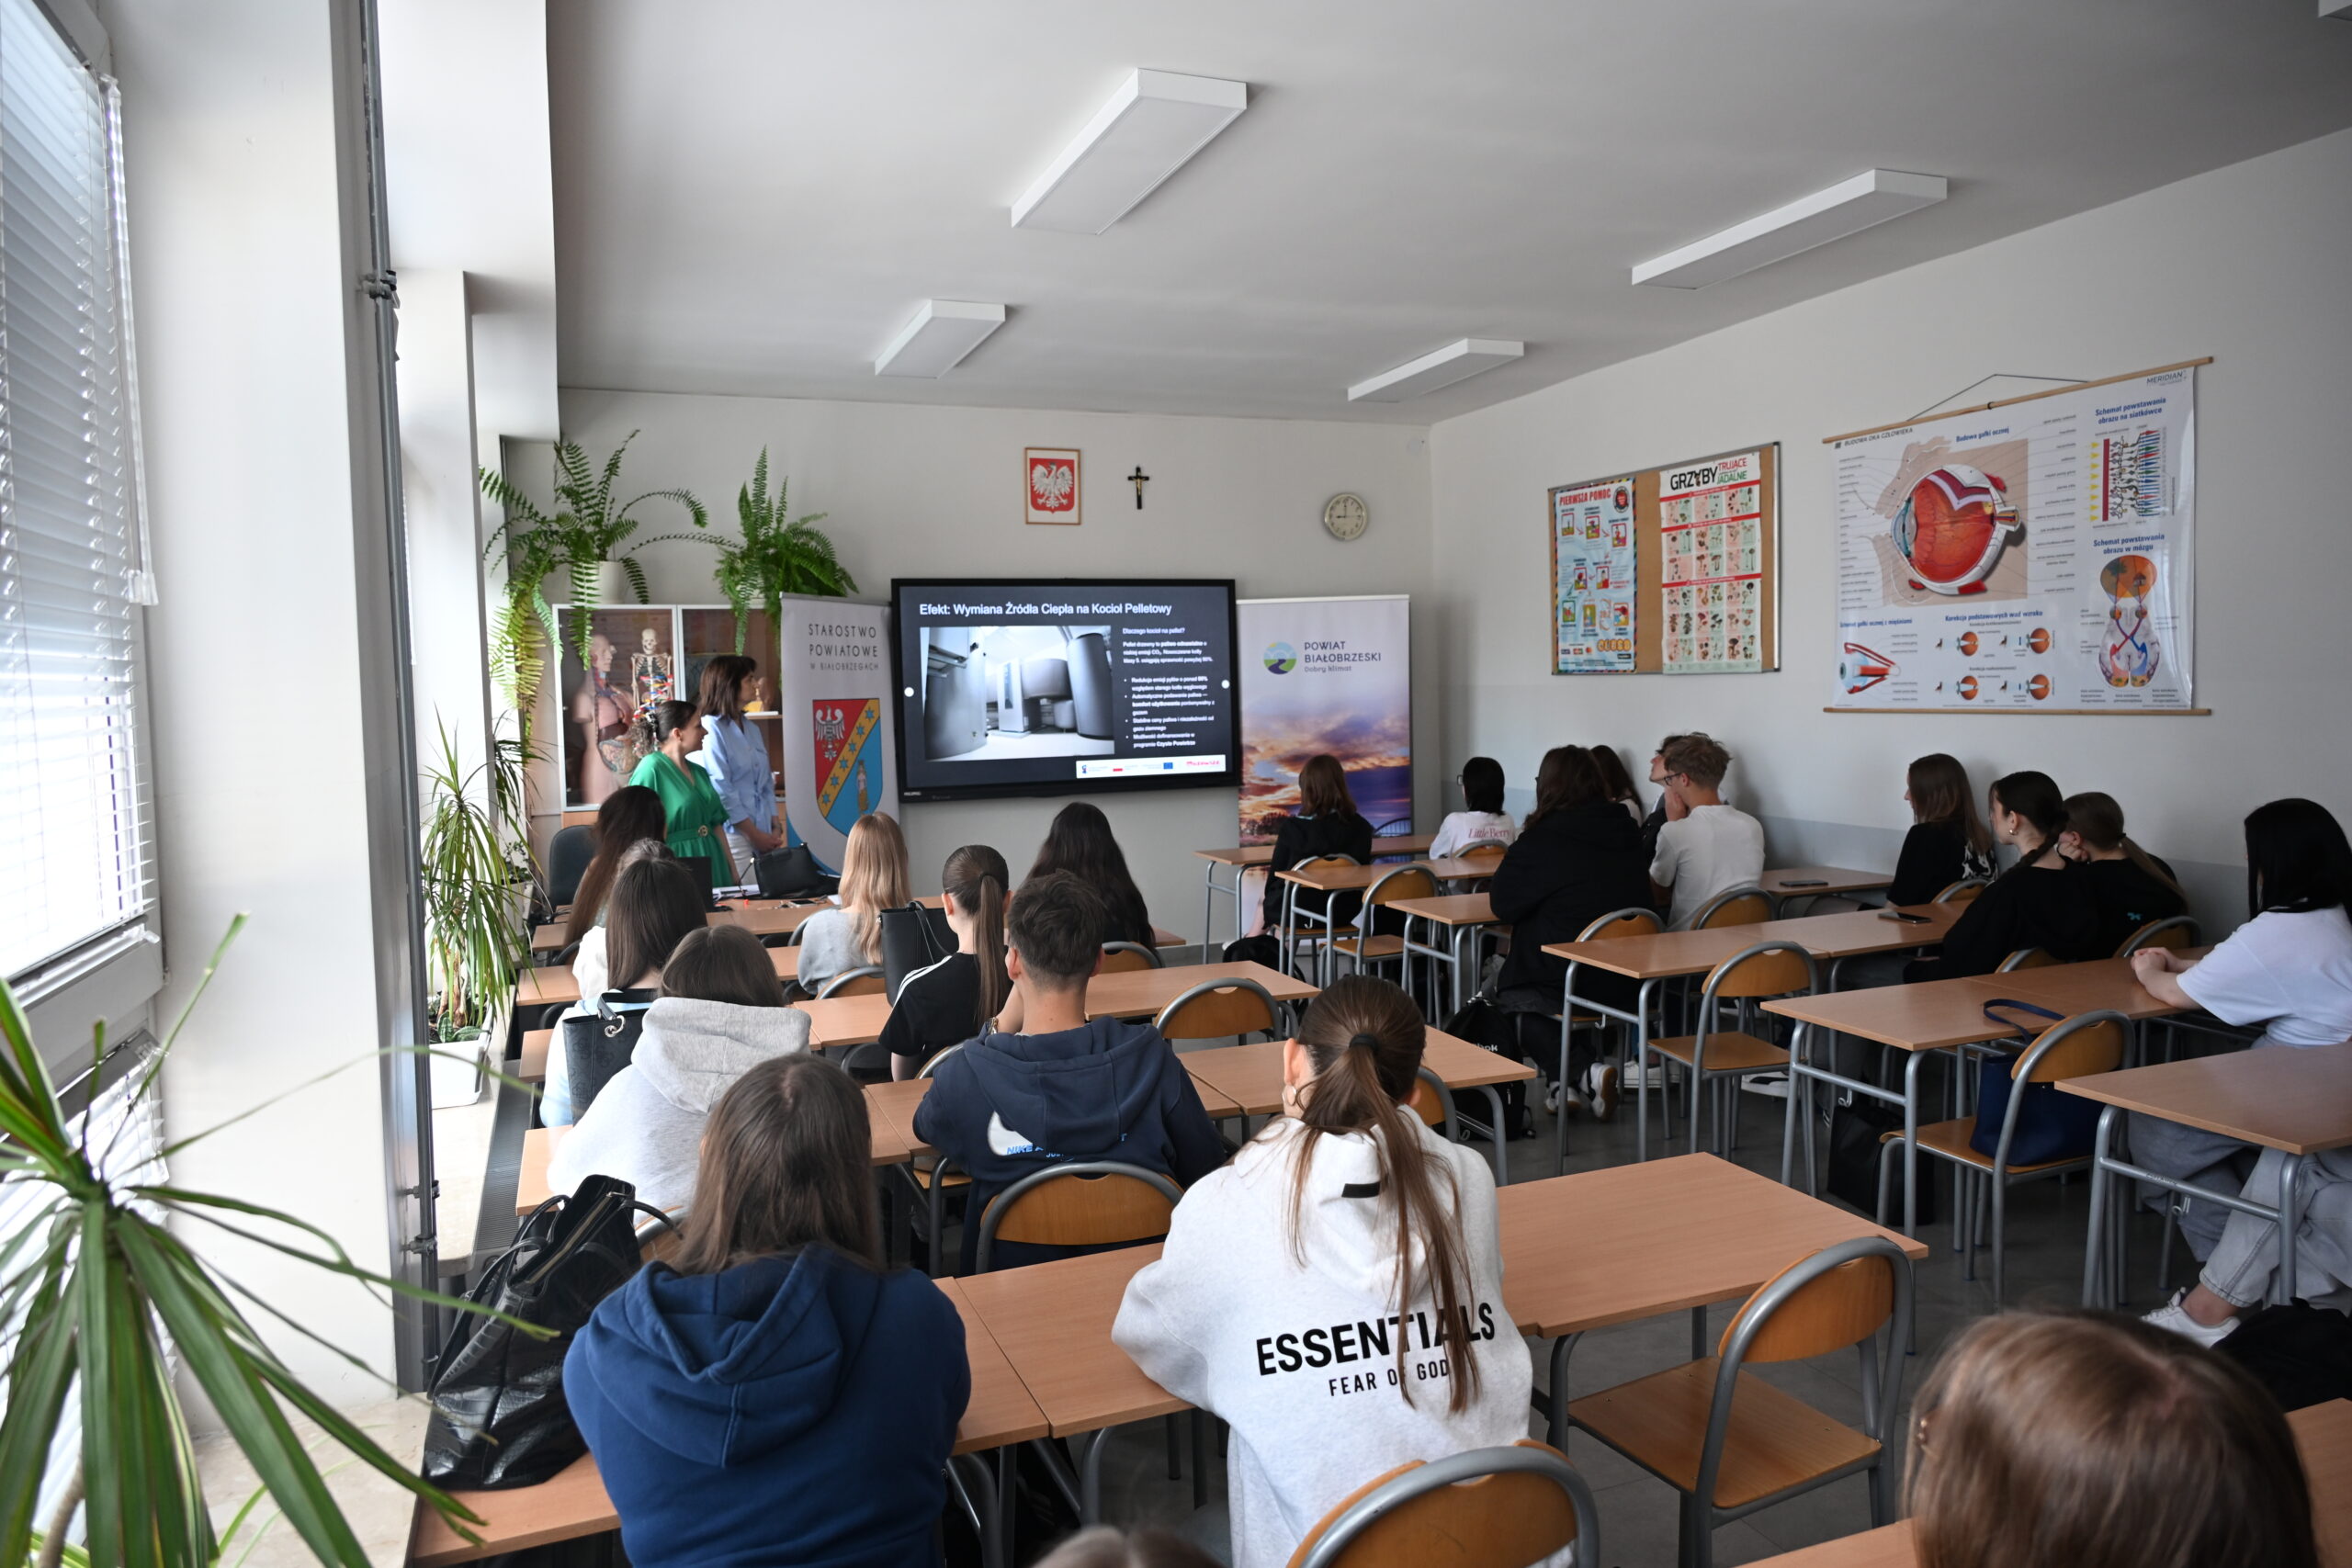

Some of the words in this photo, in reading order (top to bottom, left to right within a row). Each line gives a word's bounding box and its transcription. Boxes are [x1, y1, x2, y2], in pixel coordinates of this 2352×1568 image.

[2146, 371, 2183, 384] MERIDIAN
[2095, 406, 2122, 416] Schemat
[2123, 397, 2166, 412] powstawania
[1670, 466, 1718, 491] GRZYBY
[2093, 538, 2120, 547] Schemat
[2120, 533, 2165, 545] powstawania
[920, 604, 950, 615] Efekt:
[954, 604, 1002, 616] Wymiana
[1005, 602, 1038, 615] Źródła
[1041, 604, 1073, 616] Ciepła
[1077, 605, 1090, 615] na
[1125, 603, 1172, 616] Pelletowy
[808, 624, 876, 638] STAROSTWO
[809, 644, 878, 658] POWIATOWE
[1305, 641, 1346, 650] POWIAT
[1305, 652, 1381, 663] BIAŁOBRZESKI
[820, 662, 879, 671] BIAŁOBRZEGACH
[1006, 1145, 1034, 1156] NIKE
[1329, 1371, 1377, 1396] FEAR
[1416, 1359, 1450, 1381] GOD
